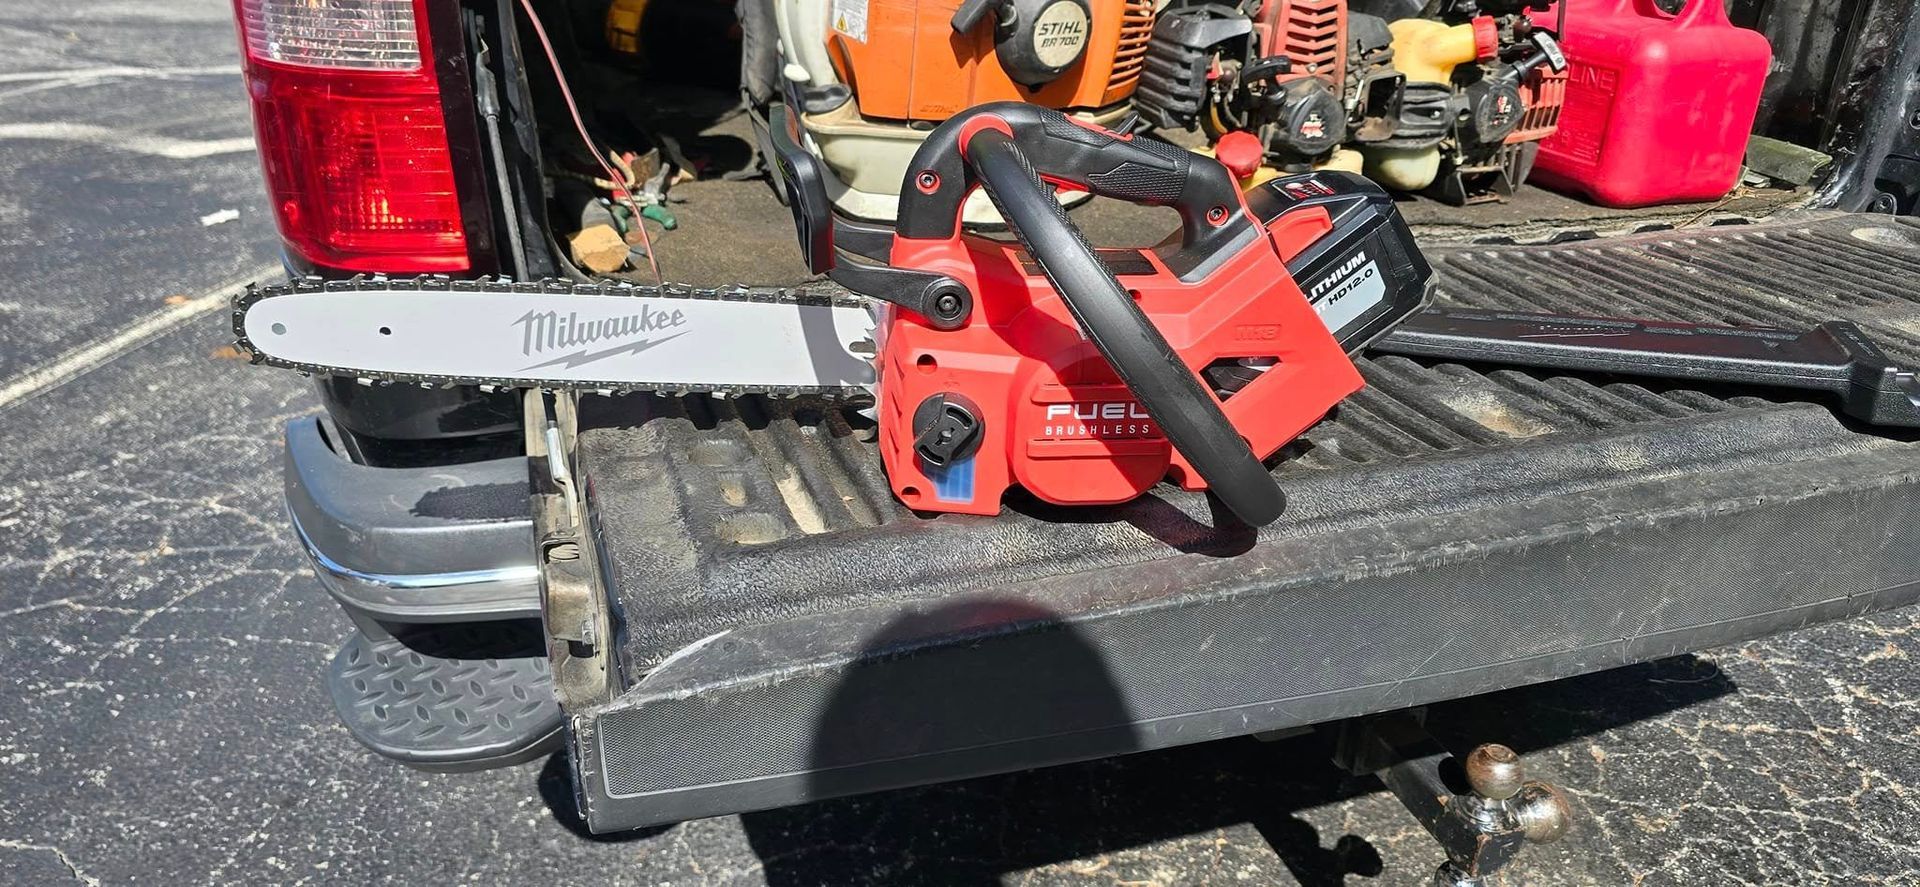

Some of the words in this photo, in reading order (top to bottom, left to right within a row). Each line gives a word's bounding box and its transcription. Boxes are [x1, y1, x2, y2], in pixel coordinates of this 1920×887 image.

[1038, 21, 1082, 36] STIHL
[1059, 36, 1079, 46] 700
[1568, 62, 1616, 92] LINE
[1328, 268, 1374, 306] HD12.0
[510, 303, 688, 357] Milwaukee
[1046, 402, 1150, 421] FUEL
[1045, 424, 1150, 436] BRUSHLESS
